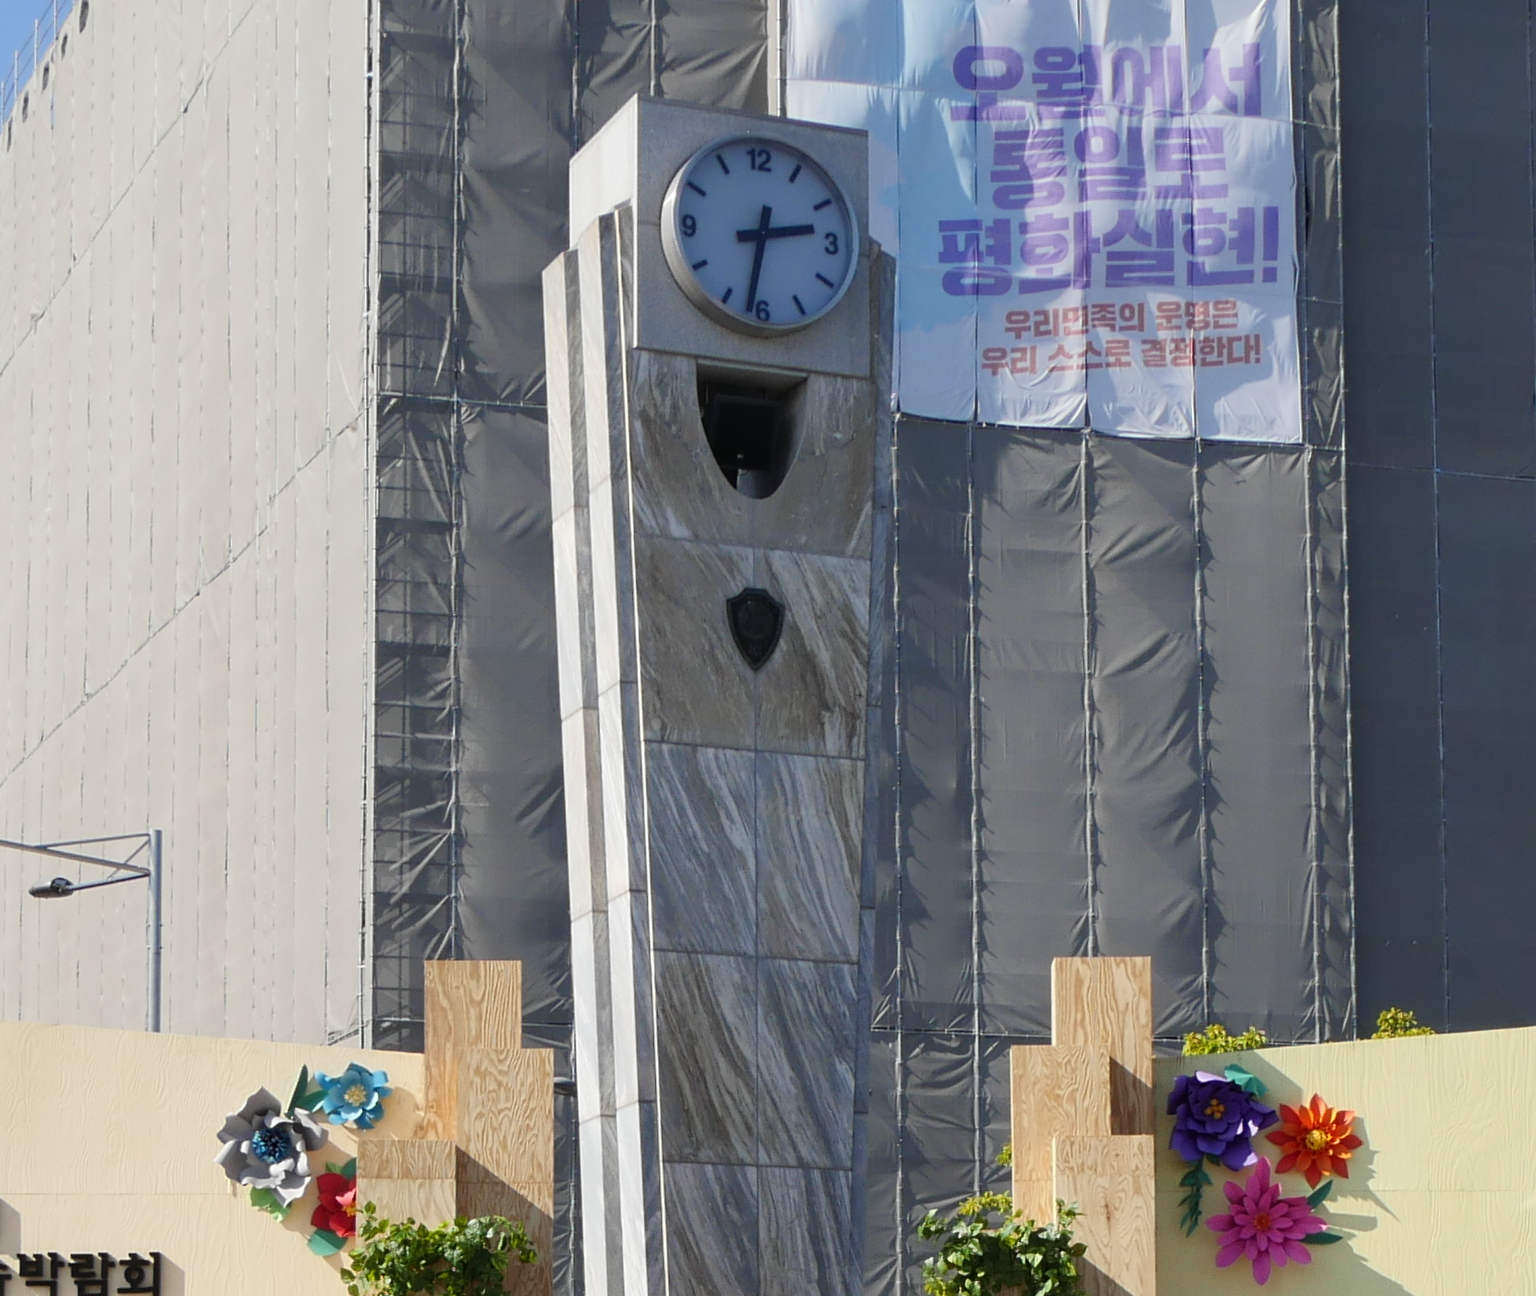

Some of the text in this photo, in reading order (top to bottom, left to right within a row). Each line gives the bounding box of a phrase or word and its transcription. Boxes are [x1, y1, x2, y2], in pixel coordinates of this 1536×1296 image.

[950, 42, 1262, 122] 오월에서
[746, 148, 772, 172] 12
[990, 126, 1230, 210] 통일로
[682, 215, 697, 236] 9
[825, 233, 839, 255] 3
[938, 206, 1280, 297] 평화실현!
[755, 300, 770, 322] 6
[1156, 300, 1238, 332] 운명은
[981, 333, 1262, 377] 우리 스스로 결정한다!
